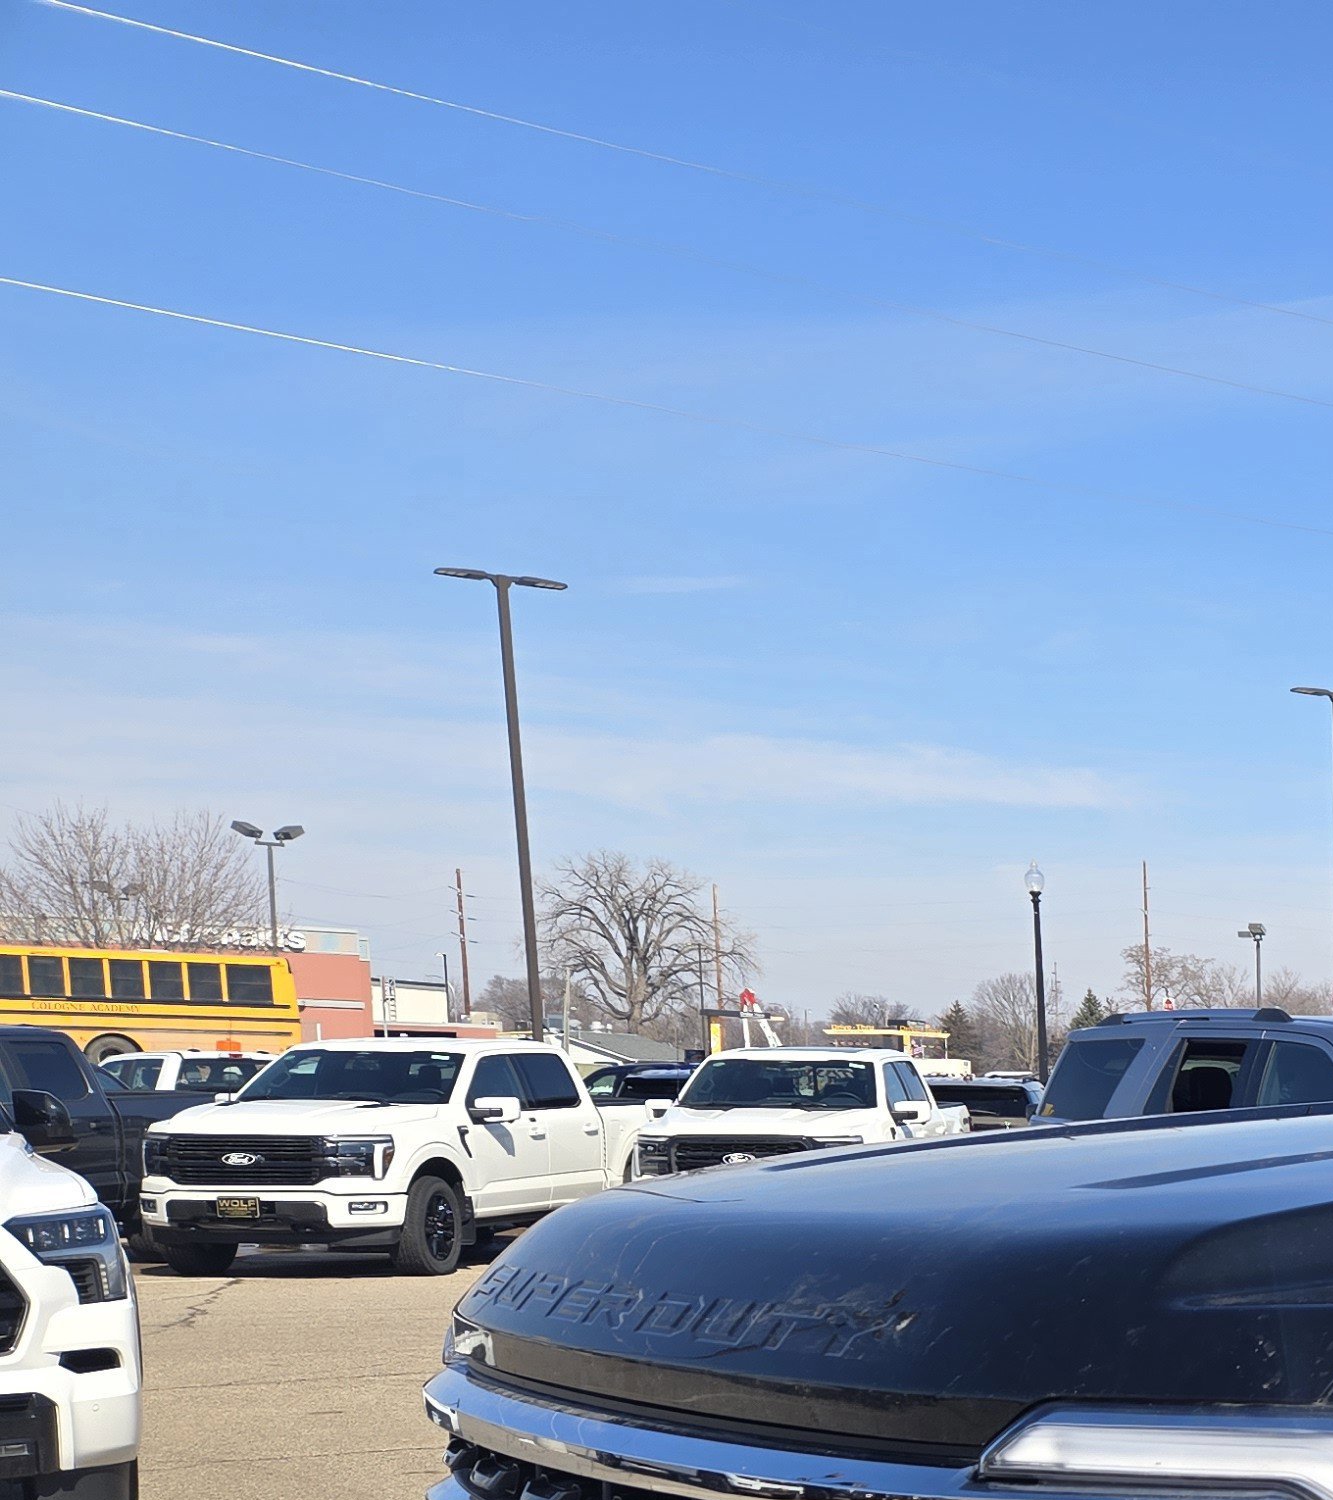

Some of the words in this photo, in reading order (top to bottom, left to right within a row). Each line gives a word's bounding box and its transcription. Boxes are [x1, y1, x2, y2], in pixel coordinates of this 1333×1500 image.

[31, 1001, 85, 1011] COLOGNE
[90, 1002, 140, 1013] ACADEMY
[218, 1199, 256, 1207] WOLF
[473, 1264, 642, 1331] SUPER
[635, 1291, 918, 1360] DUTY
